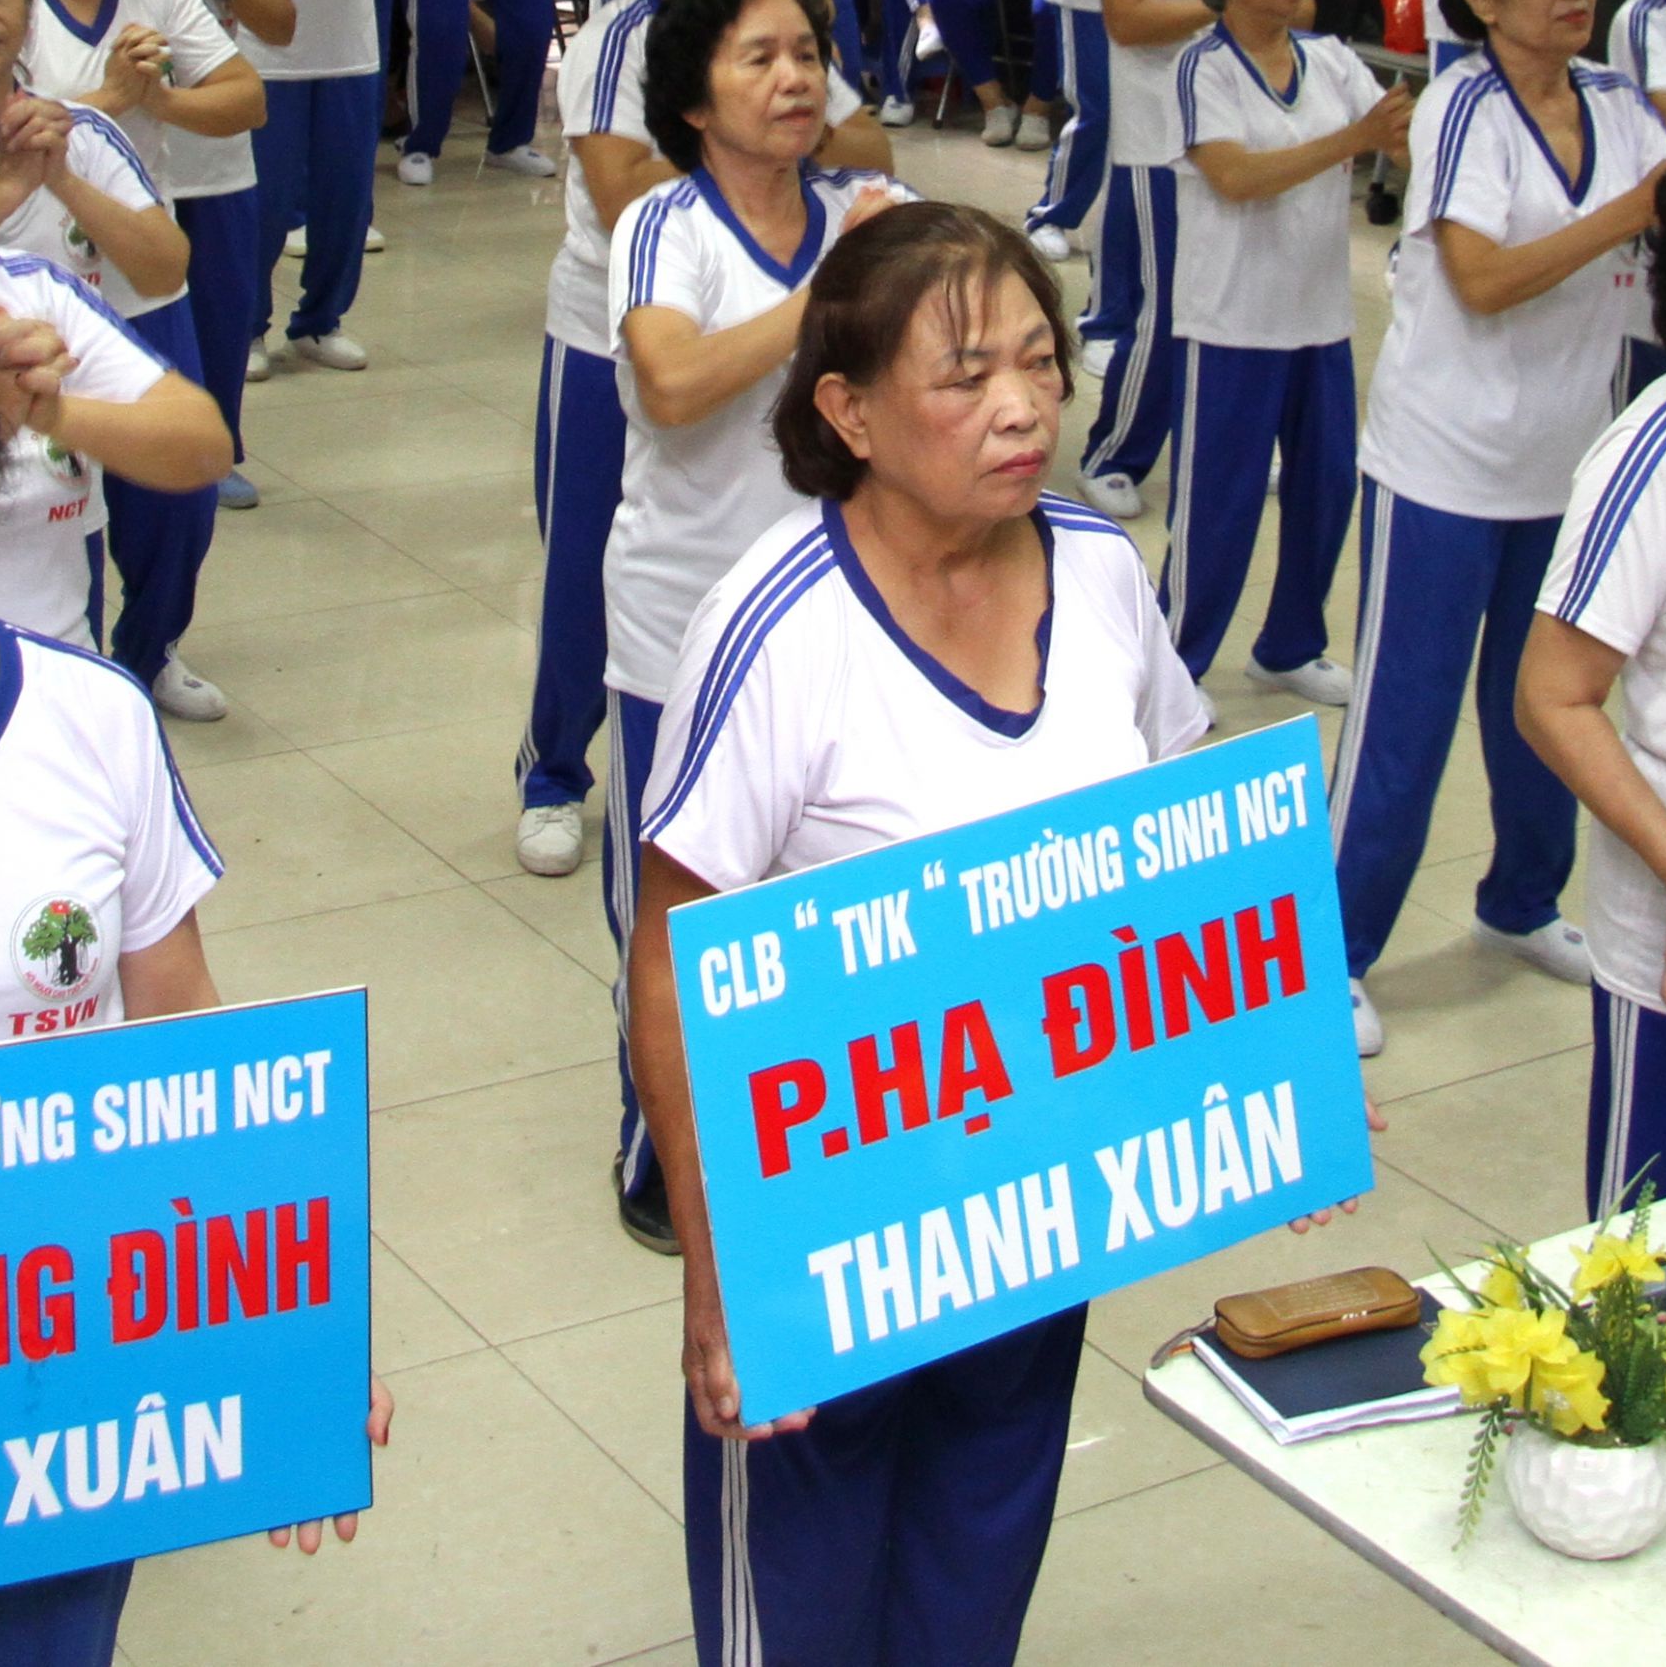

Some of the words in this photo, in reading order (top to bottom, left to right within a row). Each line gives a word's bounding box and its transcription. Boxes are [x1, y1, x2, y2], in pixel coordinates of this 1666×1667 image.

[699, 931, 788, 1019] CLB
[957, 824, 1127, 937] TRƯỜNG
[1131, 789, 1231, 881] SINH
[1233, 761, 1309, 848] NCT
[8, 994, 100, 1037] TSVN
[746, 998, 1016, 1181] P.HẠ
[1039, 890, 1309, 1081] ĐÌNH
[91, 1068, 218, 1154] SINH
[232, 1049, 333, 1131] NCT
[105, 1195, 331, 1346] ĐÌNH
[806, 1162, 1082, 1356] THANH
[1093, 1079, 1304, 1254] XUÂN
[2, 1391, 244, 1526] XUÂN
